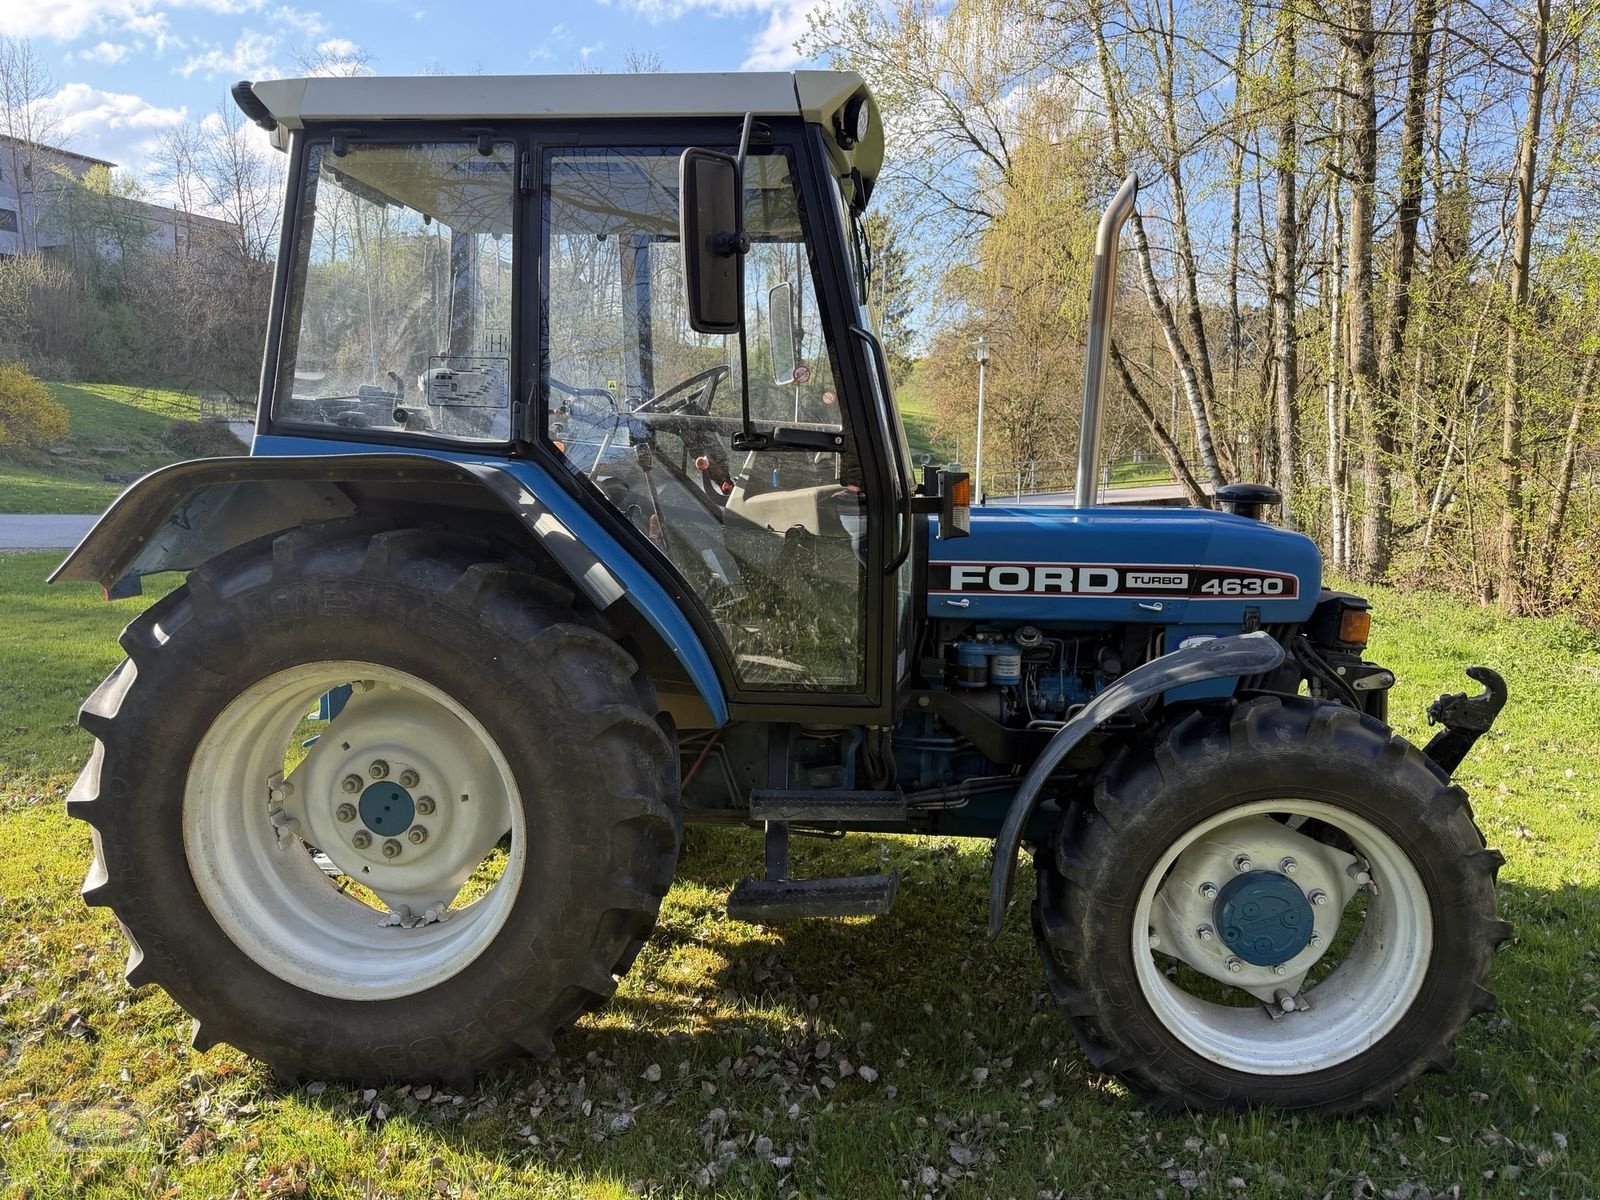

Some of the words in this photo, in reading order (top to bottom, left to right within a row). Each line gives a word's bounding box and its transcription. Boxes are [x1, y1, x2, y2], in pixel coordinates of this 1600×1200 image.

[950, 566, 1119, 593] FORD
[1131, 575, 1183, 586] TURBO
[1200, 578, 1283, 595] 4630
